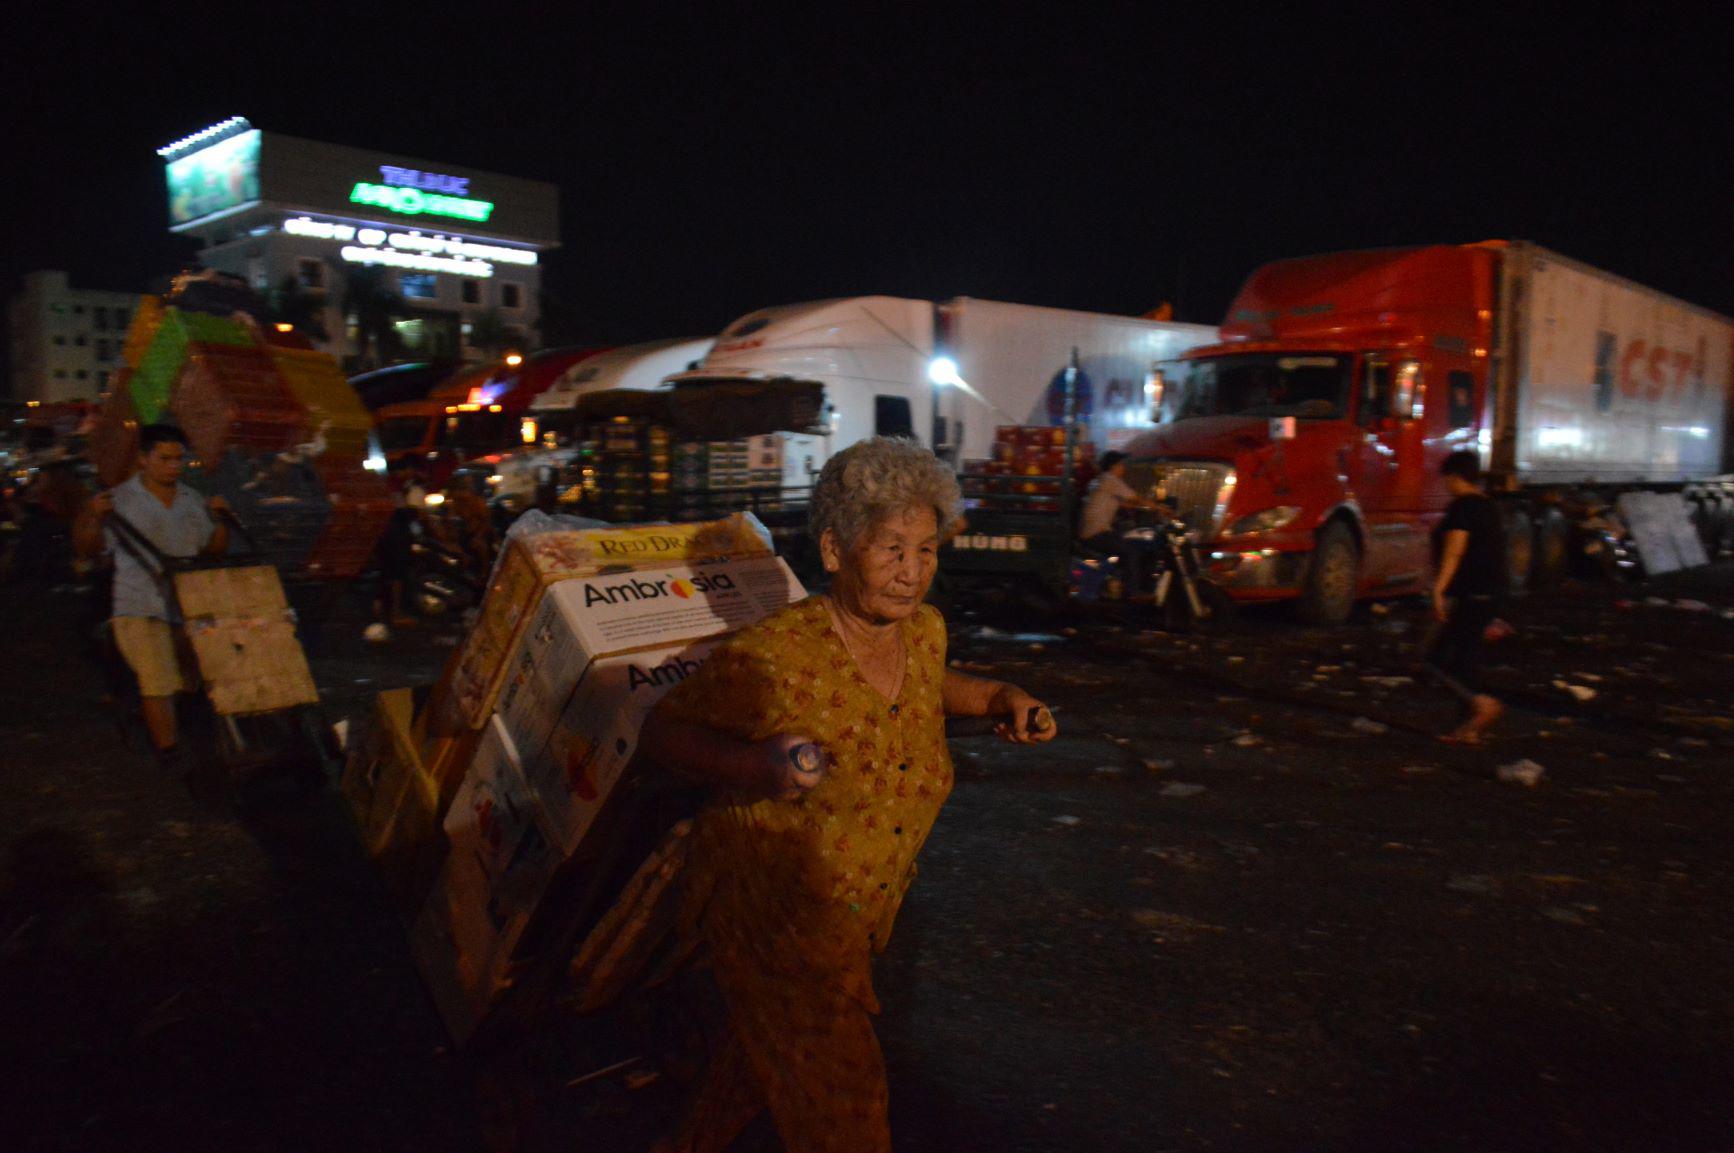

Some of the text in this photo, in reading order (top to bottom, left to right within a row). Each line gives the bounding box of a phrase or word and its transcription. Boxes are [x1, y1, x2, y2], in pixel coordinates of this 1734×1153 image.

[599, 538, 648, 555] RED
[585, 571, 736, 608] Ambrosia
[628, 656, 705, 692] Amb
